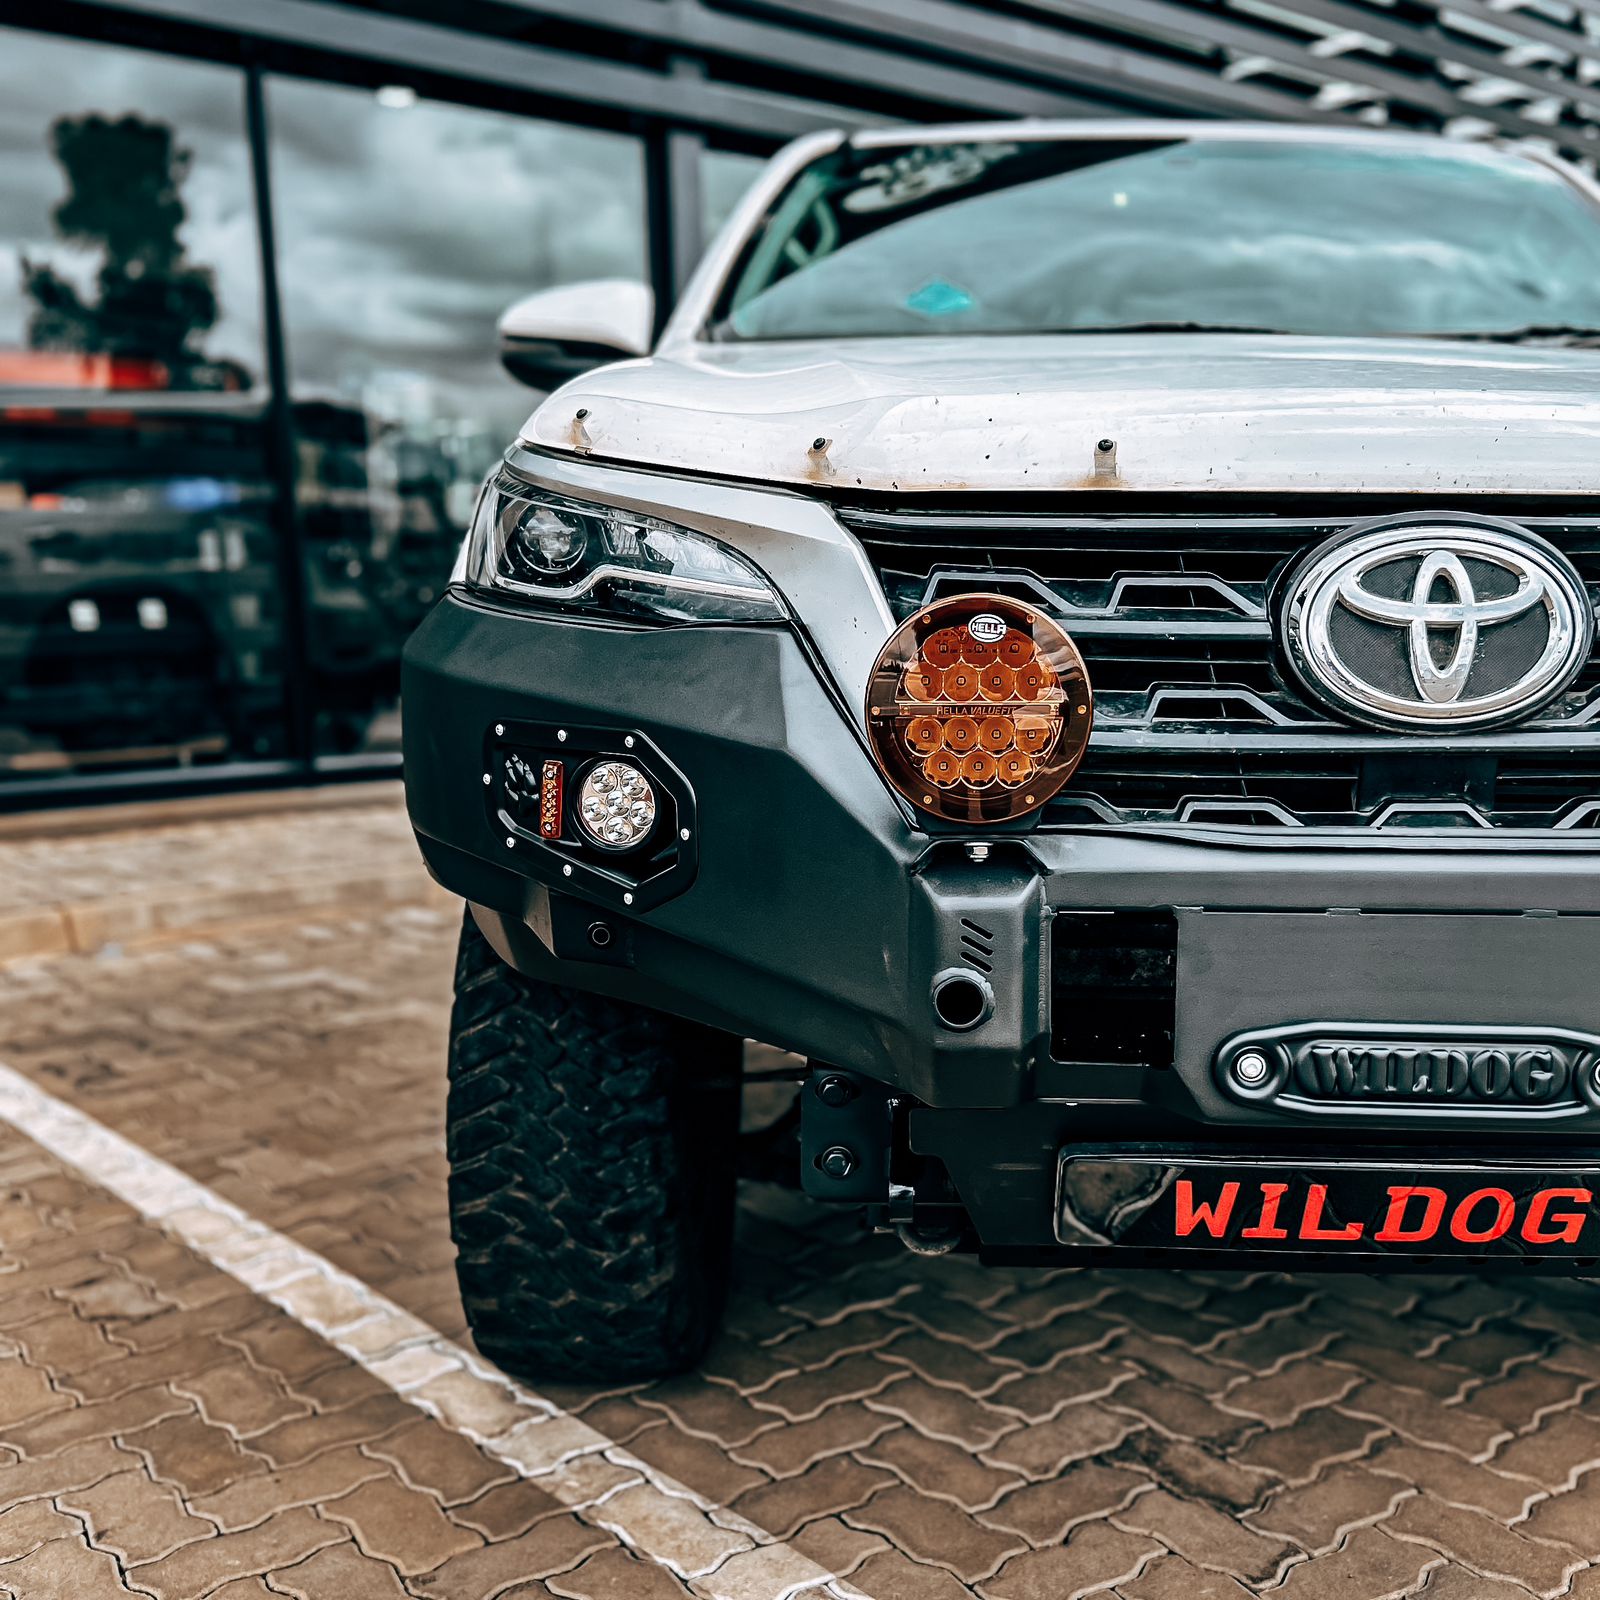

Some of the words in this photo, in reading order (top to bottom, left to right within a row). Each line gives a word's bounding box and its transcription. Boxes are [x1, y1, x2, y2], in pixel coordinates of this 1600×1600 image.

[971, 622, 1007, 635] HELLA
[936, 705, 969, 715] HELLA
[1308, 1045, 1556, 1097] WILDOG
[1175, 1180, 1593, 1243] WILDOG
